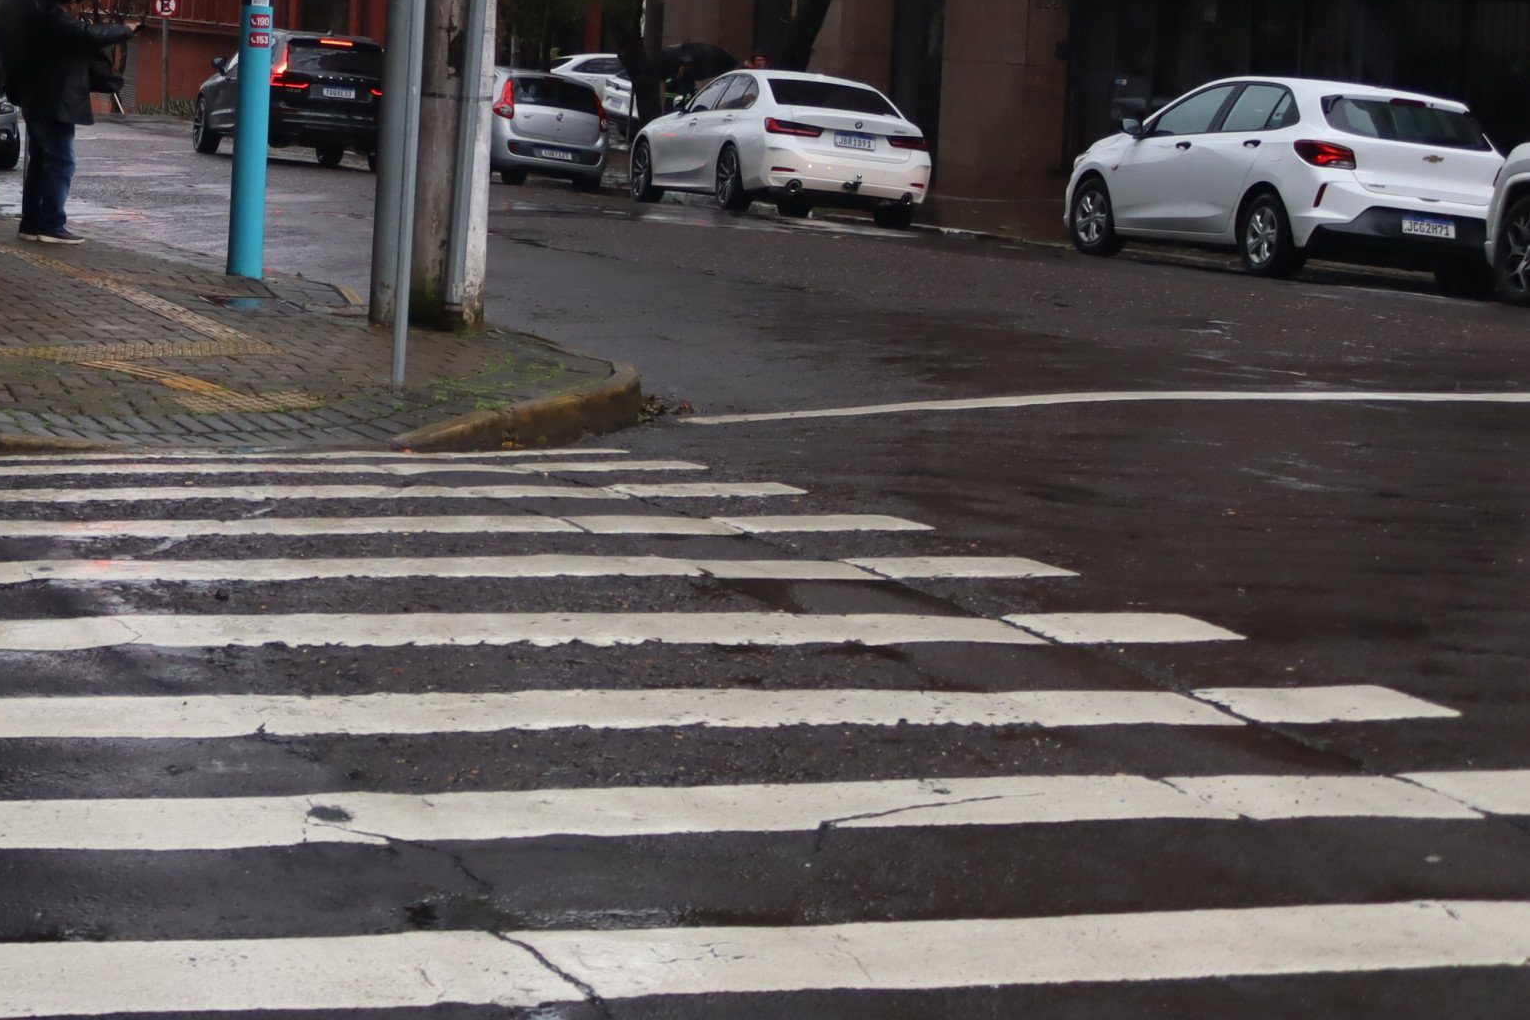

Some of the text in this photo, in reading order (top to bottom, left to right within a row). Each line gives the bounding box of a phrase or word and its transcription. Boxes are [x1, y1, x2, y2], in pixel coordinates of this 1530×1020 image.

[256, 16, 270, 26] 190
[255, 35, 269, 44] 153
[1407, 220, 1450, 237] JCG2H71
